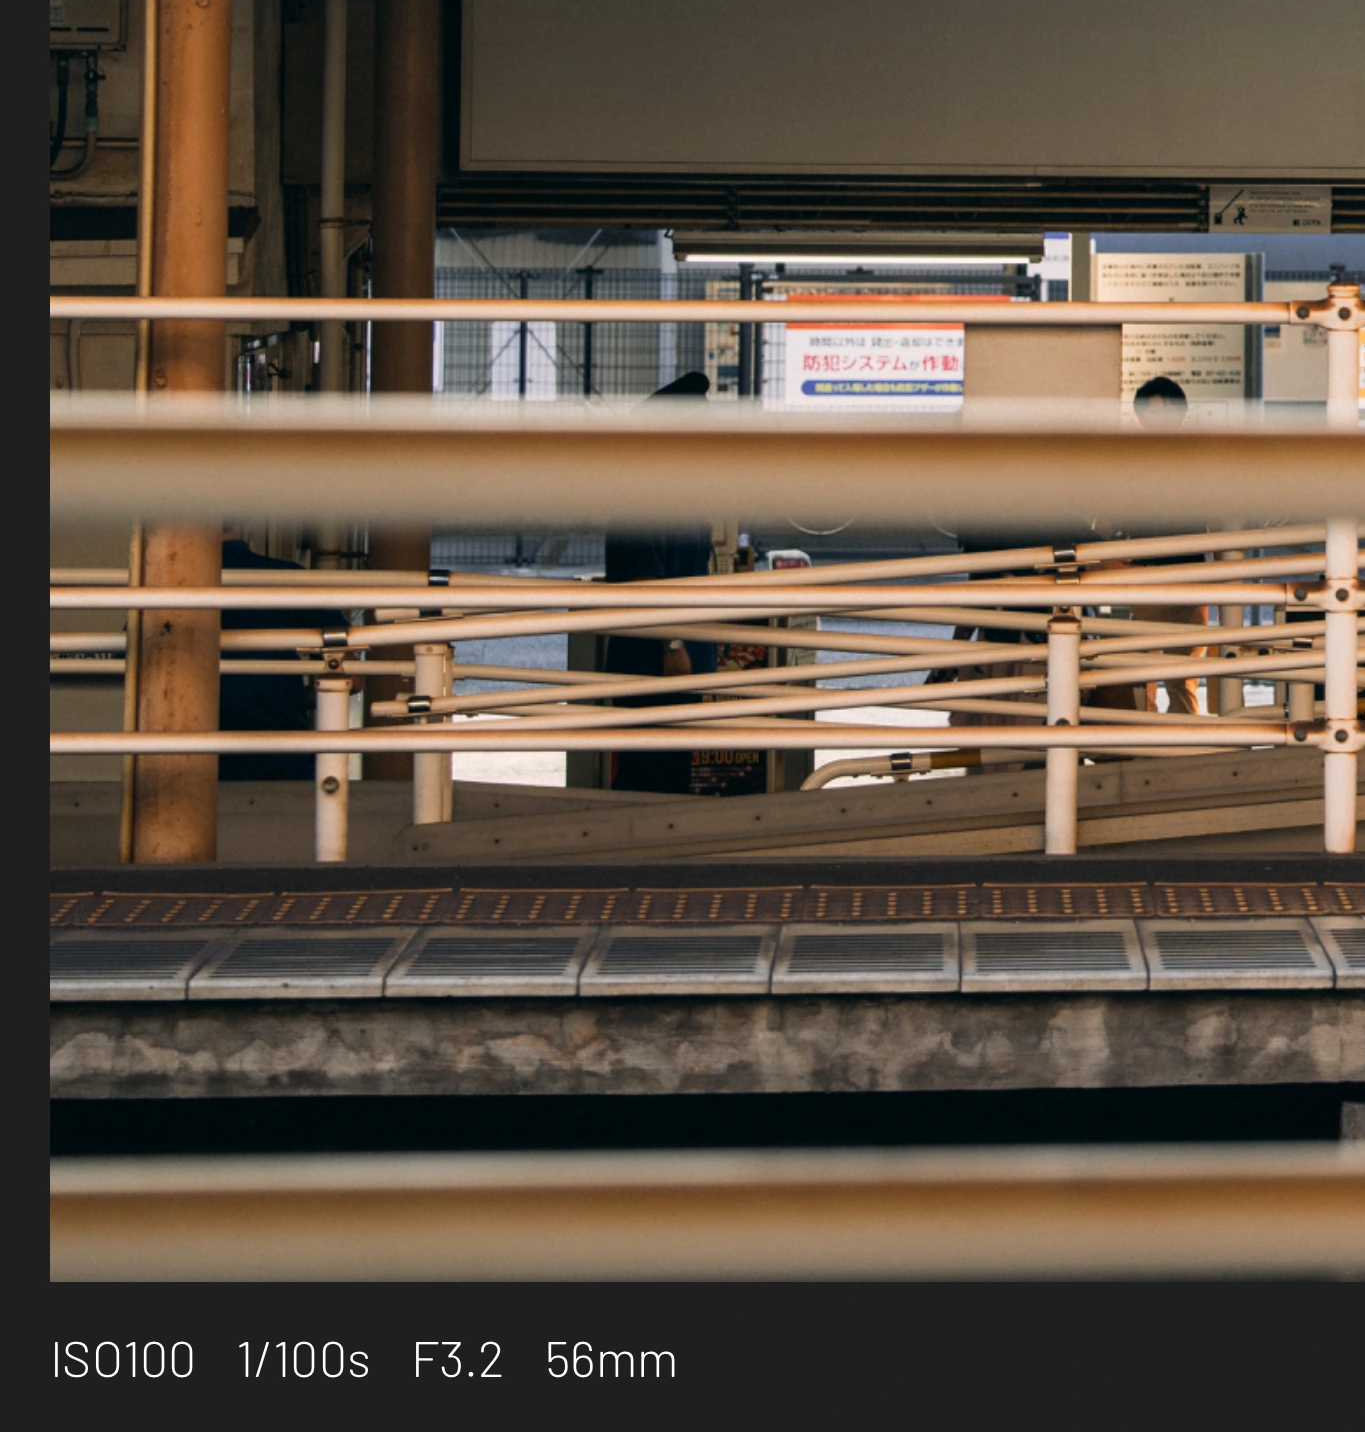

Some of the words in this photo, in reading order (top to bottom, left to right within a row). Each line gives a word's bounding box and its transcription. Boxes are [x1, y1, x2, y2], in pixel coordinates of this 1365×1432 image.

[803, 354, 964, 372] 防犯システムが作動
